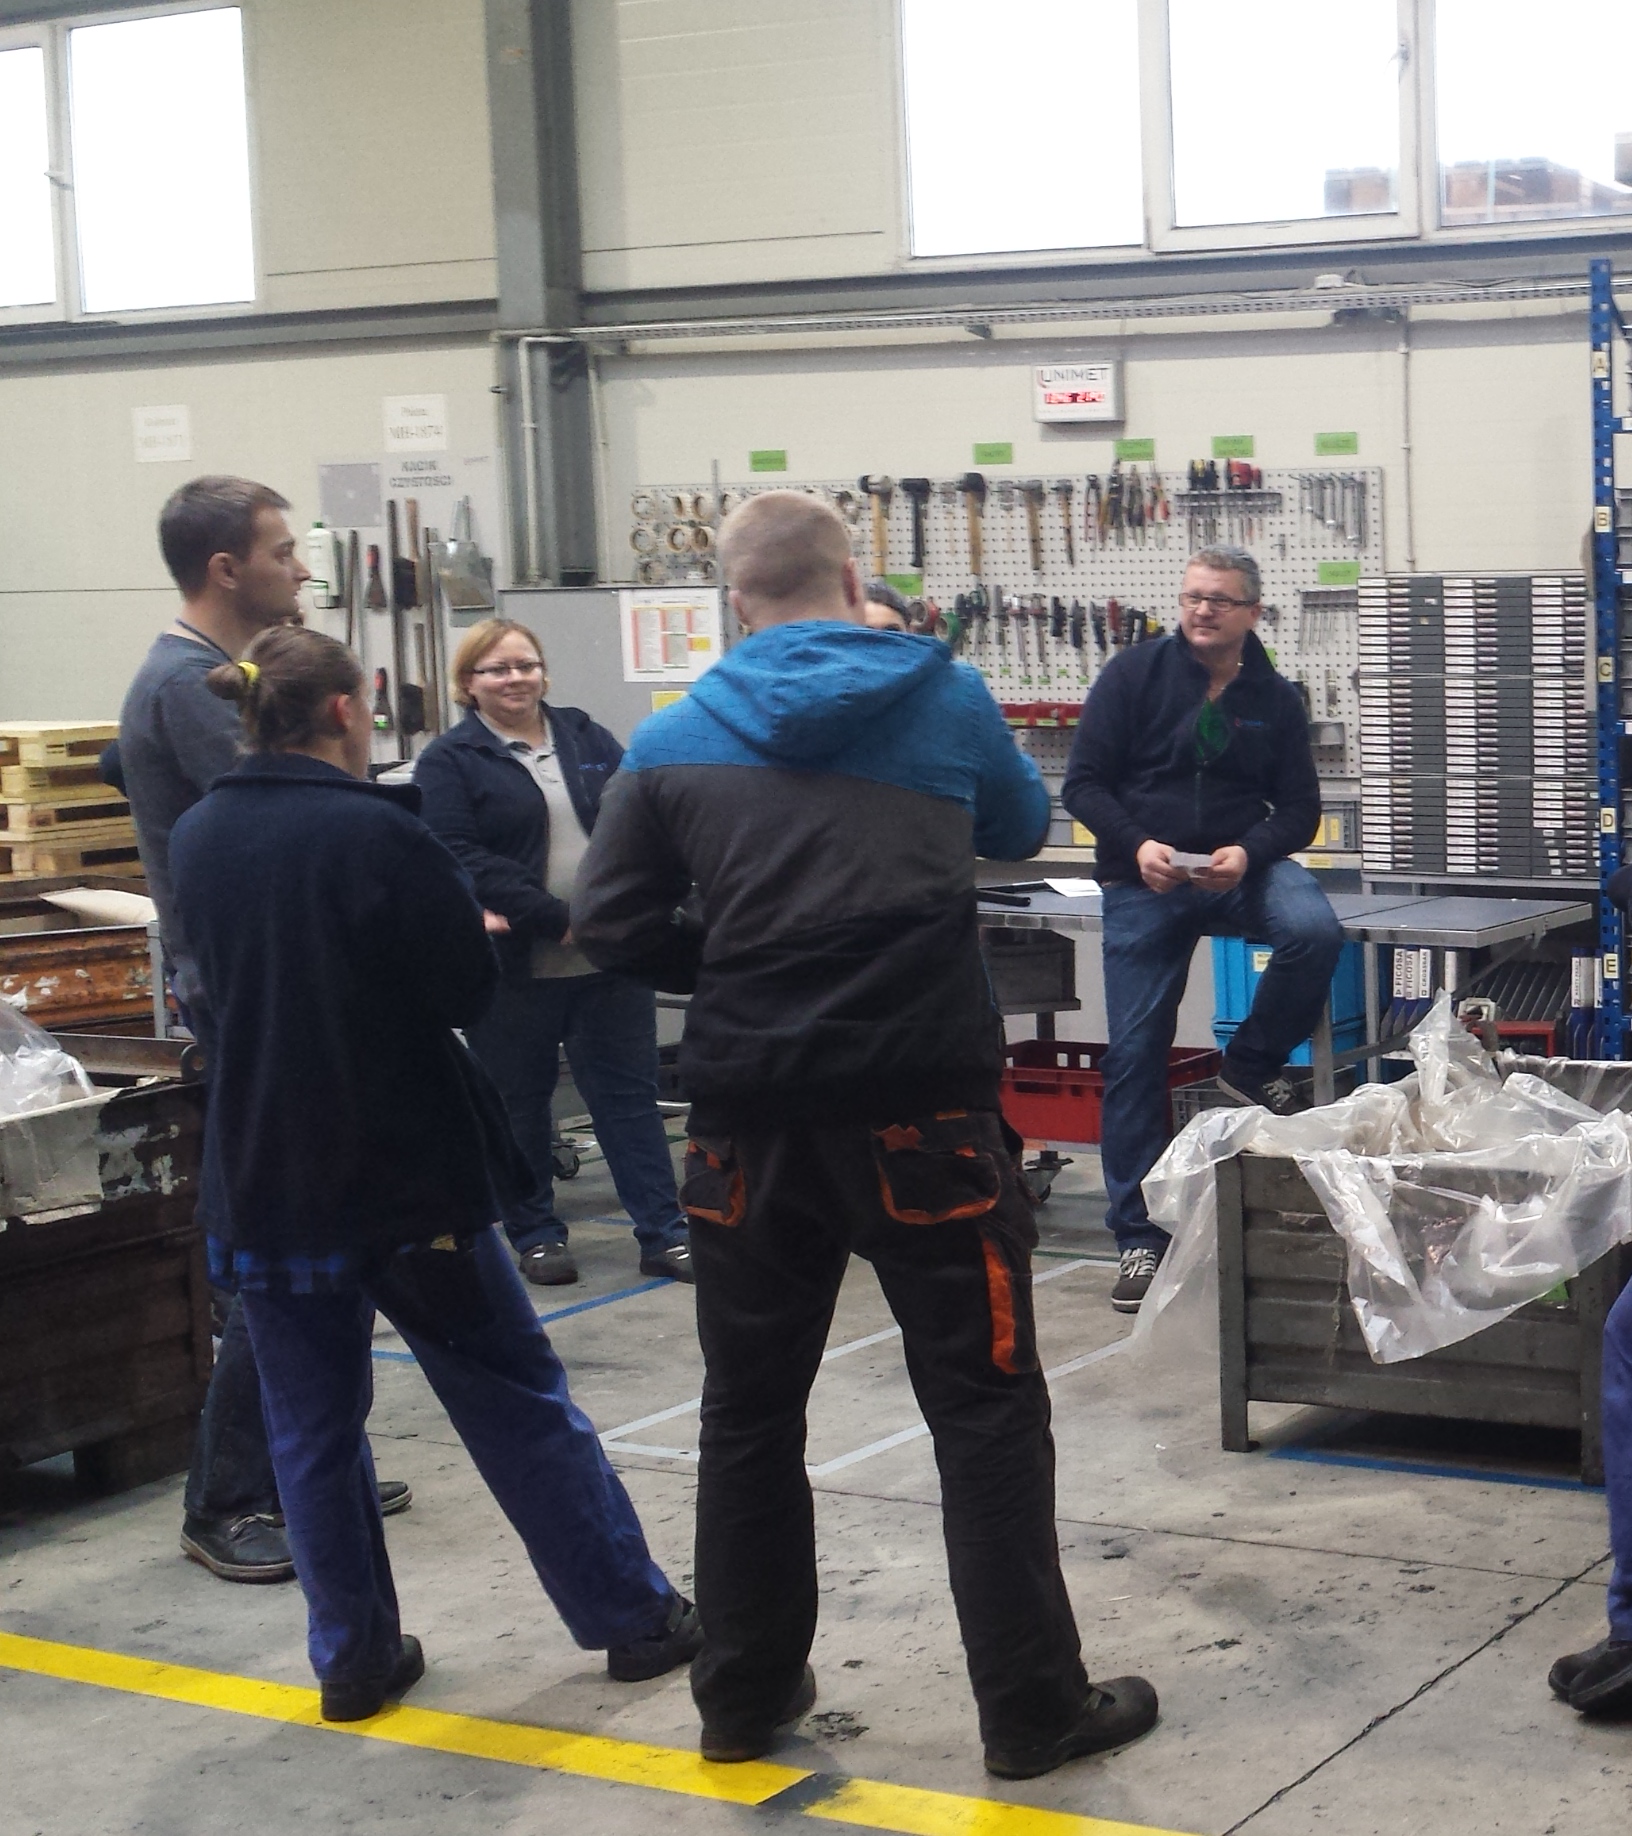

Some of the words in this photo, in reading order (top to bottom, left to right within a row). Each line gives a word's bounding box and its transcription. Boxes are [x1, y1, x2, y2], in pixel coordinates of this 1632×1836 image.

[1038, 367, 1110, 386] UNIMET
[1597, 511, 1608, 527] B
[1600, 662, 1612, 677] C
[1602, 813, 1614, 827] D
[1395, 950, 1403, 986] FICOSA
[1405, 953, 1413, 988] FICOSA
[1606, 959, 1617, 973] E
